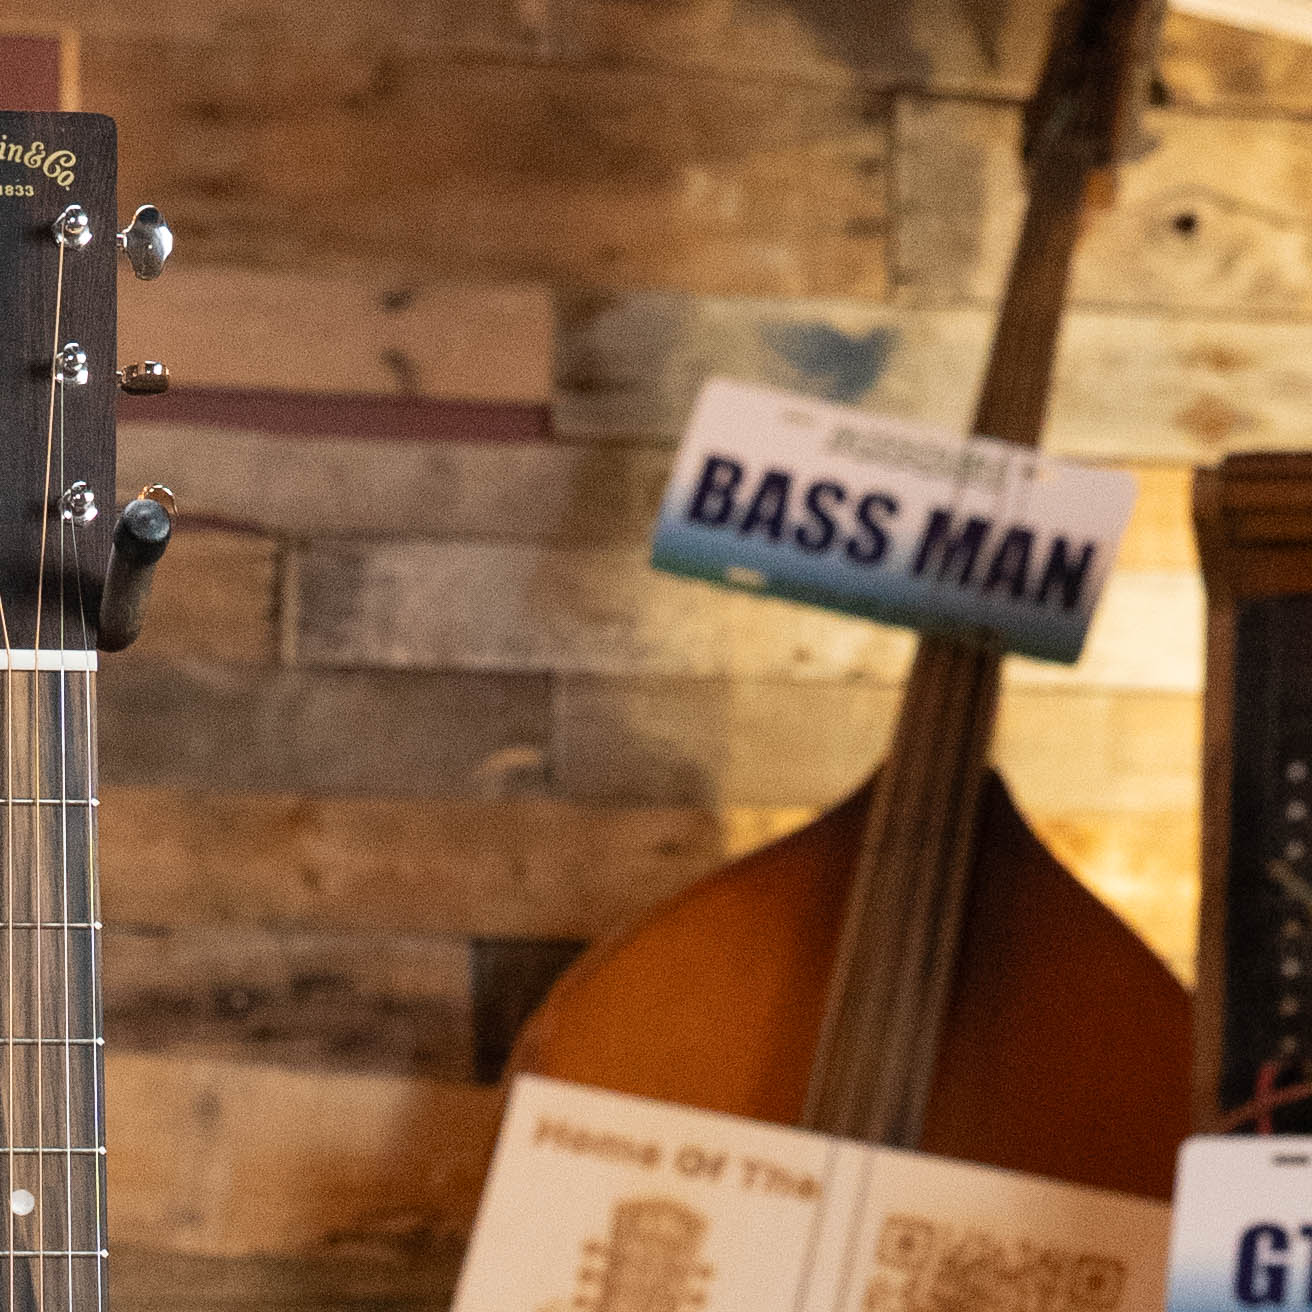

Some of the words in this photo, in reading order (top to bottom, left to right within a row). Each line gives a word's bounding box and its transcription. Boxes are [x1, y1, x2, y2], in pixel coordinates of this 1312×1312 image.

[685, 452, 900, 566] BASS
[913, 506, 1098, 611] MAN
[533, 1117, 660, 1169] Home
[742, 1158, 820, 1198] The
